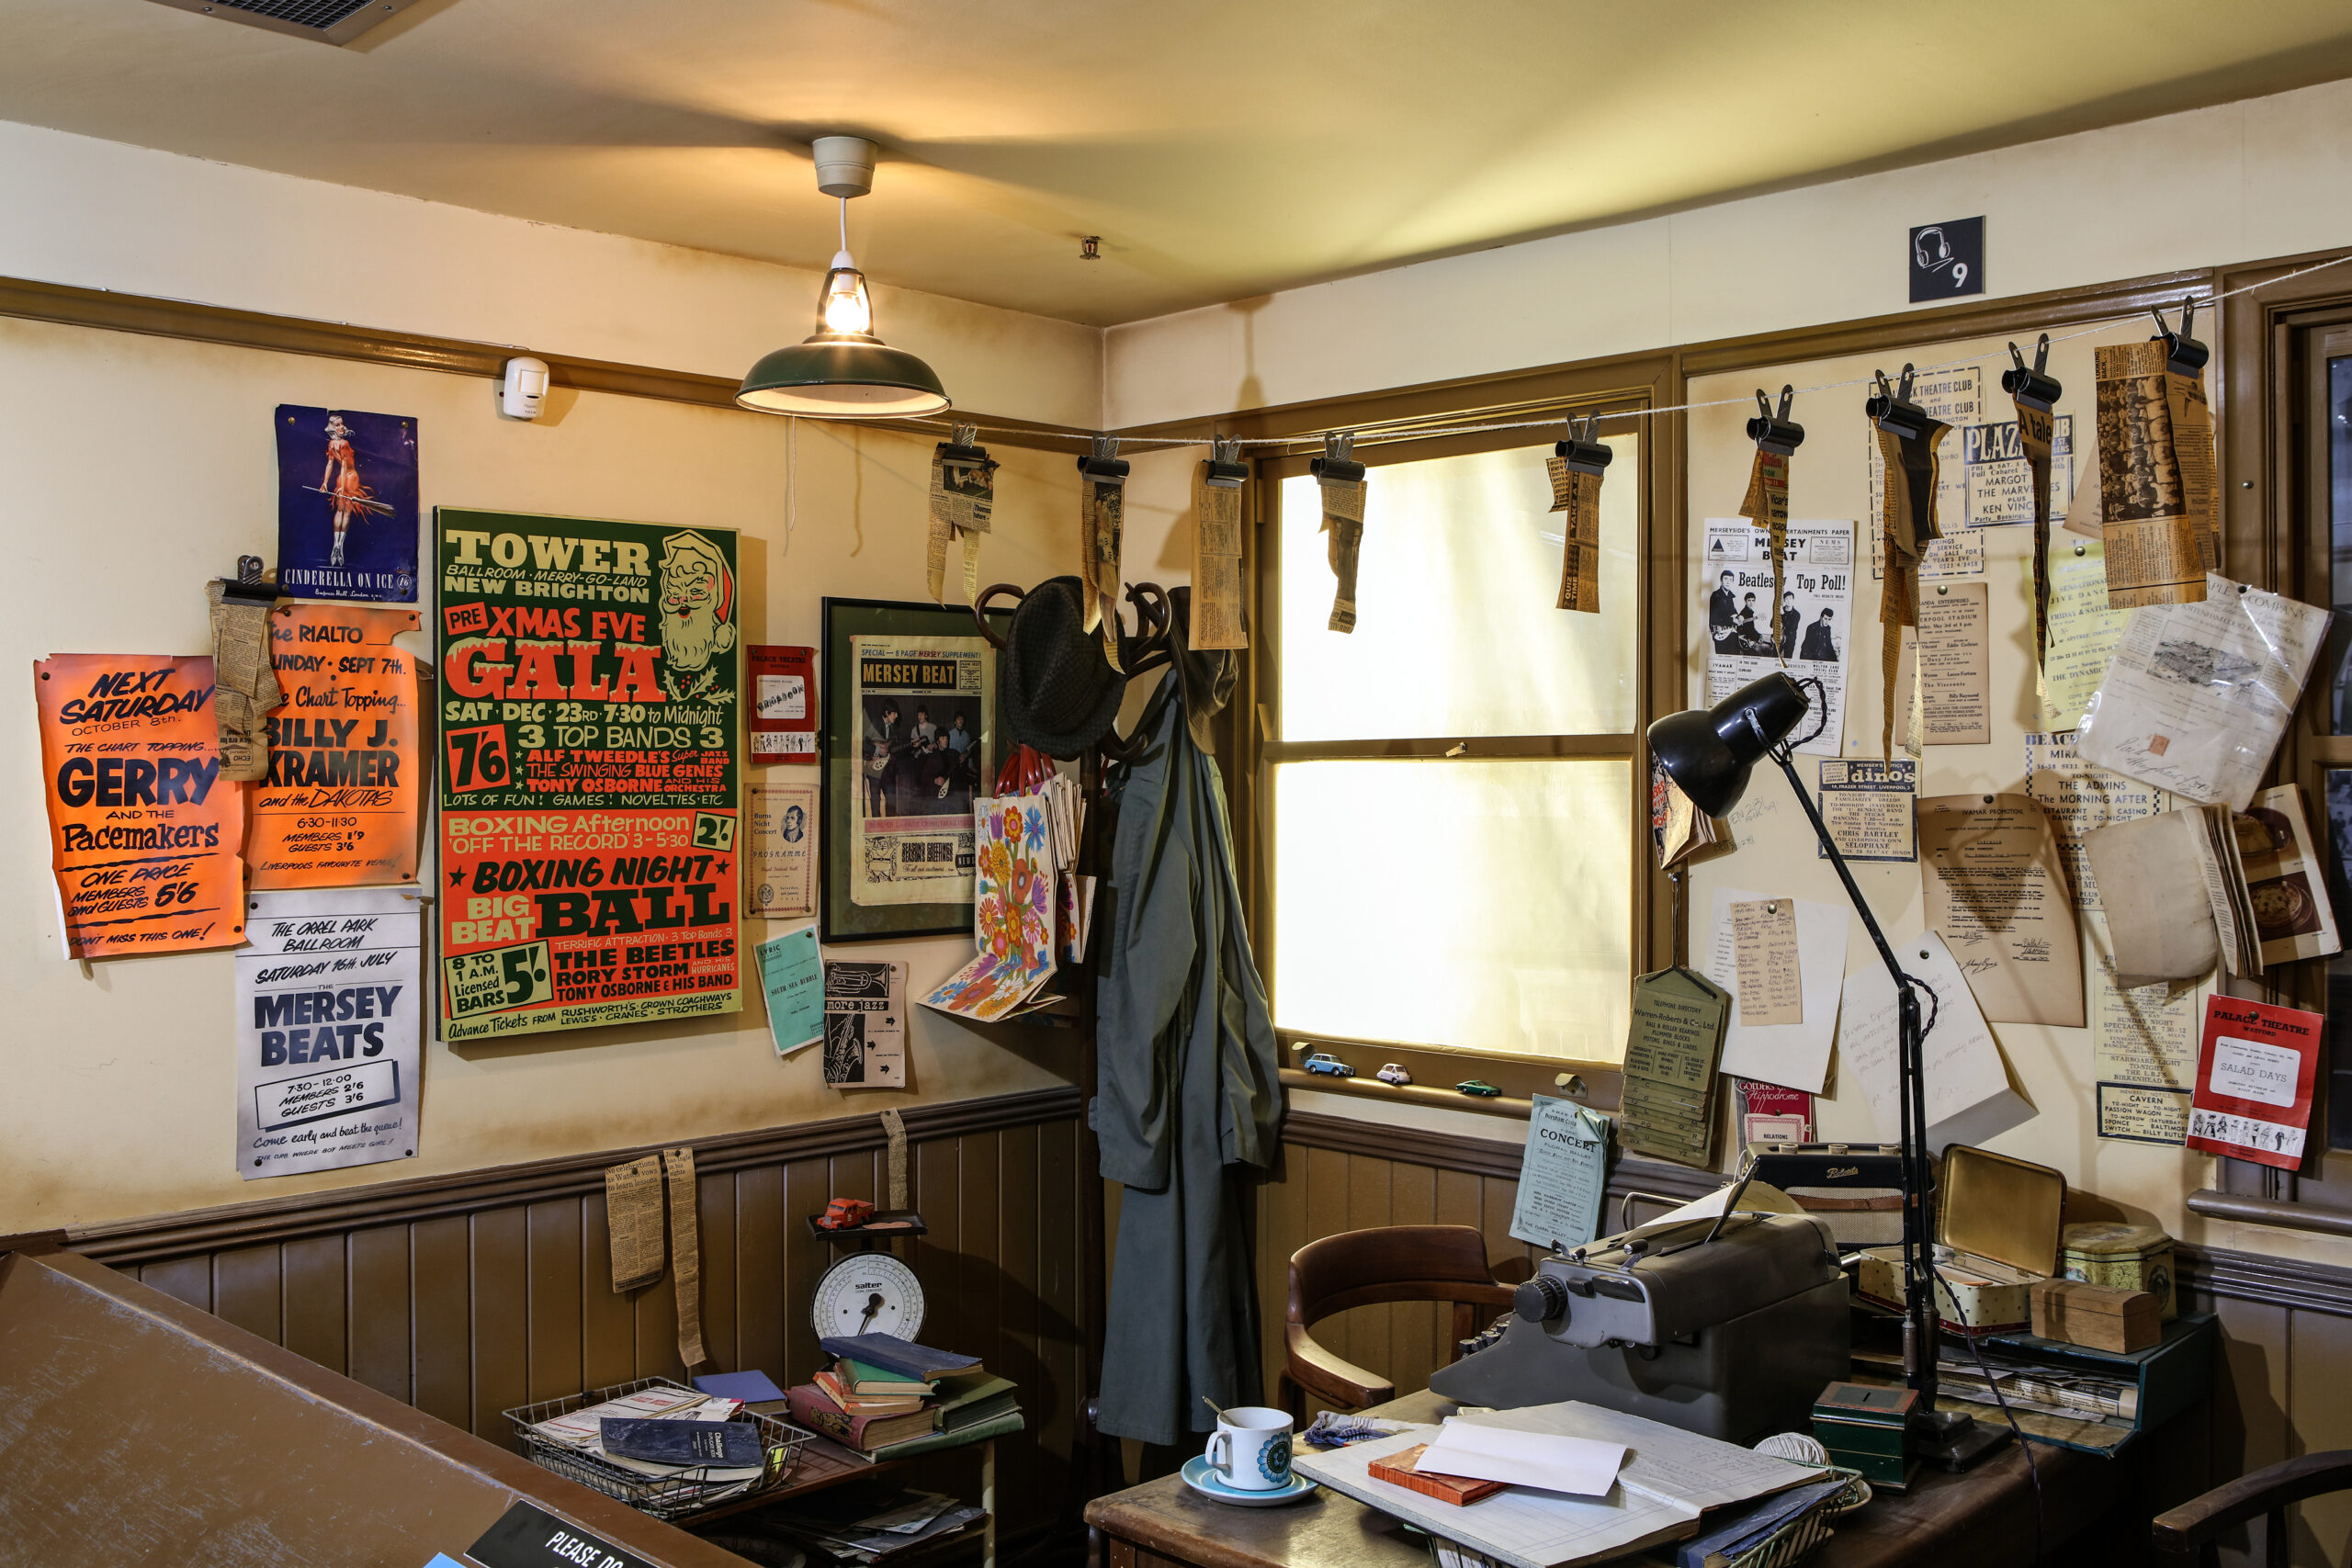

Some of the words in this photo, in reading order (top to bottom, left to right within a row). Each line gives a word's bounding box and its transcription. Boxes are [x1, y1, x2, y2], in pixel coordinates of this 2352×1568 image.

[1952, 263, 1968, 288] 9
[1920, 383, 1952, 395] THEATRE
[1954, 379, 1973, 390] CLUB
[1955, 402, 1973, 413] CLUB
[2031, 418, 2051, 445] tale
[1985, 475, 2027, 486] MARGOT
[1977, 489, 1996, 498] THE
[1983, 504, 2001, 513] KEN
[446, 529, 651, 576] TOWER
[285, 569, 352, 588] CINDERELLA
[358, 573, 371, 588] ON
[377, 574, 393, 589] ICE
[447, 564, 526, 580] BALLROOM
[533, 570, 648, 587] MERRY-GO-LAND
[1738, 571, 1774, 588] Beatles
[1797, 574, 1815, 592] Top
[444, 576, 506, 595] NEW
[515, 582, 650, 604] BRIGHTON
[299, 624, 363, 644] RIALTO
[449, 607, 482, 629] PRE
[486, 606, 581, 638] XMAS
[592, 611, 646, 642] EVE
[338, 657, 375, 674] SEPT
[445, 637, 667, 703] GALA
[864, 663, 918, 682] MERSEY
[922, 665, 955, 683] BEAT
[88, 668, 175, 698] NEXT
[59, 684, 215, 725] SATURDAY
[296, 685, 339, 707] Chart
[445, 701, 490, 722] SAT
[503, 702, 547, 722] DEC
[556, 703, 598, 722] 23RD
[648, 707, 662, 724] to
[664, 705, 724, 727] Midnight
[72, 719, 141, 737] OCTOBER
[266, 718, 359, 748] BILLY
[368, 720, 399, 748] J.
[517, 725, 546, 748] 3
[553, 725, 599, 747] TOP
[606, 726, 692, 749] BANDS
[699, 726, 724, 749] 3
[65, 742, 95, 753] THE
[96, 742, 140, 752] CHART
[526, 750, 564, 762] ALF
[571, 750, 671, 763] TWEEDLE'S
[259, 750, 400, 787] KRAMER
[526, 763, 557, 777] THE
[560, 762, 631, 777] SWINGING
[635, 764, 670, 777] BLUE
[673, 763, 724, 777] GENES
[1851, 768, 1916, 783] dino's
[57, 757, 220, 807] GERRY
[526, 778, 580, 793] TONY
[582, 778, 663, 793] OSBORNE
[664, 784, 727, 793] ORCHESTRA
[2059, 781, 2078, 790] THE
[2086, 782, 2127, 790] ADMINS
[259, 794, 291, 807] and
[291, 793, 310, 807] the
[309, 789, 393, 808] DAKOTAS
[2038, 795, 2054, 804] The
[2060, 795, 2110, 804] MORNING
[2115, 795, 2147, 804] AFTER
[105, 810, 141, 820] AND
[149, 810, 175, 818] THE
[448, 816, 568, 836] BOXING
[571, 814, 689, 833] Afternoon
[62, 822, 220, 852] Pacemakers
[282, 832, 342, 842] MEMBERS
[288, 843, 332, 852] GUESTS
[81, 869, 128, 888] ONE
[129, 863, 194, 882] PRICE
[472, 856, 605, 895] BOXING
[610, 854, 716, 886] NIGHT
[71, 886, 146, 904] MEMBERS
[96, 897, 149, 914] GUESTS
[467, 894, 530, 920] BIG
[534, 883, 730, 938] BALL
[272, 922, 295, 937] THE
[297, 920, 336, 936] ORREL
[341, 919, 379, 933] PARK
[451, 917, 536, 945] BEAT
[283, 935, 364, 953] BALLROOM
[760, 944, 781, 956] LYRIC
[554, 948, 617, 970] THE
[626, 939, 735, 965] BEETLES
[254, 963, 329, 985] SATURDAY
[360, 951, 398, 968] JULY
[556, 969, 616, 987] RORY
[622, 964, 689, 982] STORM
[455, 976, 500, 998] Licensed
[556, 987, 596, 1003] TONY
[601, 978, 661, 998] OSBORNE
[697, 974, 733, 988] BAND
[771, 984, 786, 996] SOUTH
[788, 980, 798, 989] SEA
[800, 974, 818, 987] BUBBLE
[254, 985, 403, 1029] MERSEY
[456, 990, 505, 1013] BARS
[605, 1009, 648, 1021] CRANES
[658, 1001, 723, 1016] STROTHERS
[826, 1000, 854, 1010] more
[857, 999, 885, 1012] jazz
[448, 1021, 489, 1039] Advance
[490, 1016, 528, 1033] Tickets
[640, 998, 674, 1010] CROWN
[677, 992, 732, 1007] COACHWAYS
[1634, 1009, 1681, 1023] Warren-Roberts
[2213, 1010, 2258, 1026] PALACE
[2261, 1018, 2310, 1036] THEATRE
[2243, 1026, 2277, 1037] WATFORD
[261, 1021, 384, 1067] BEATS
[2221, 1063, 2255, 1076] SALAD
[2259, 1070, 2288, 1083] DAYS
[279, 1086, 339, 1106] MEMBERS
[1747, 1089, 1800, 1101] Hippodrome
[281, 1099, 336, 1117] GUESTS
[253, 1134, 288, 1150] Come
[290, 1130, 317, 1145] early
[320, 1129, 338, 1139] and
[338, 1125, 360, 1137] beat
[360, 1122, 372, 1134] the
[1540, 1128, 1596, 1153] CONCERT
[1544, 1142, 1568, 1154] FLORAL
[1569, 1150, 1592, 1160] BALLET
[616, 1181, 634, 1190] learn
[635, 1177, 658, 1186] lessons
[545, 1530, 602, 1567] PLEASE
